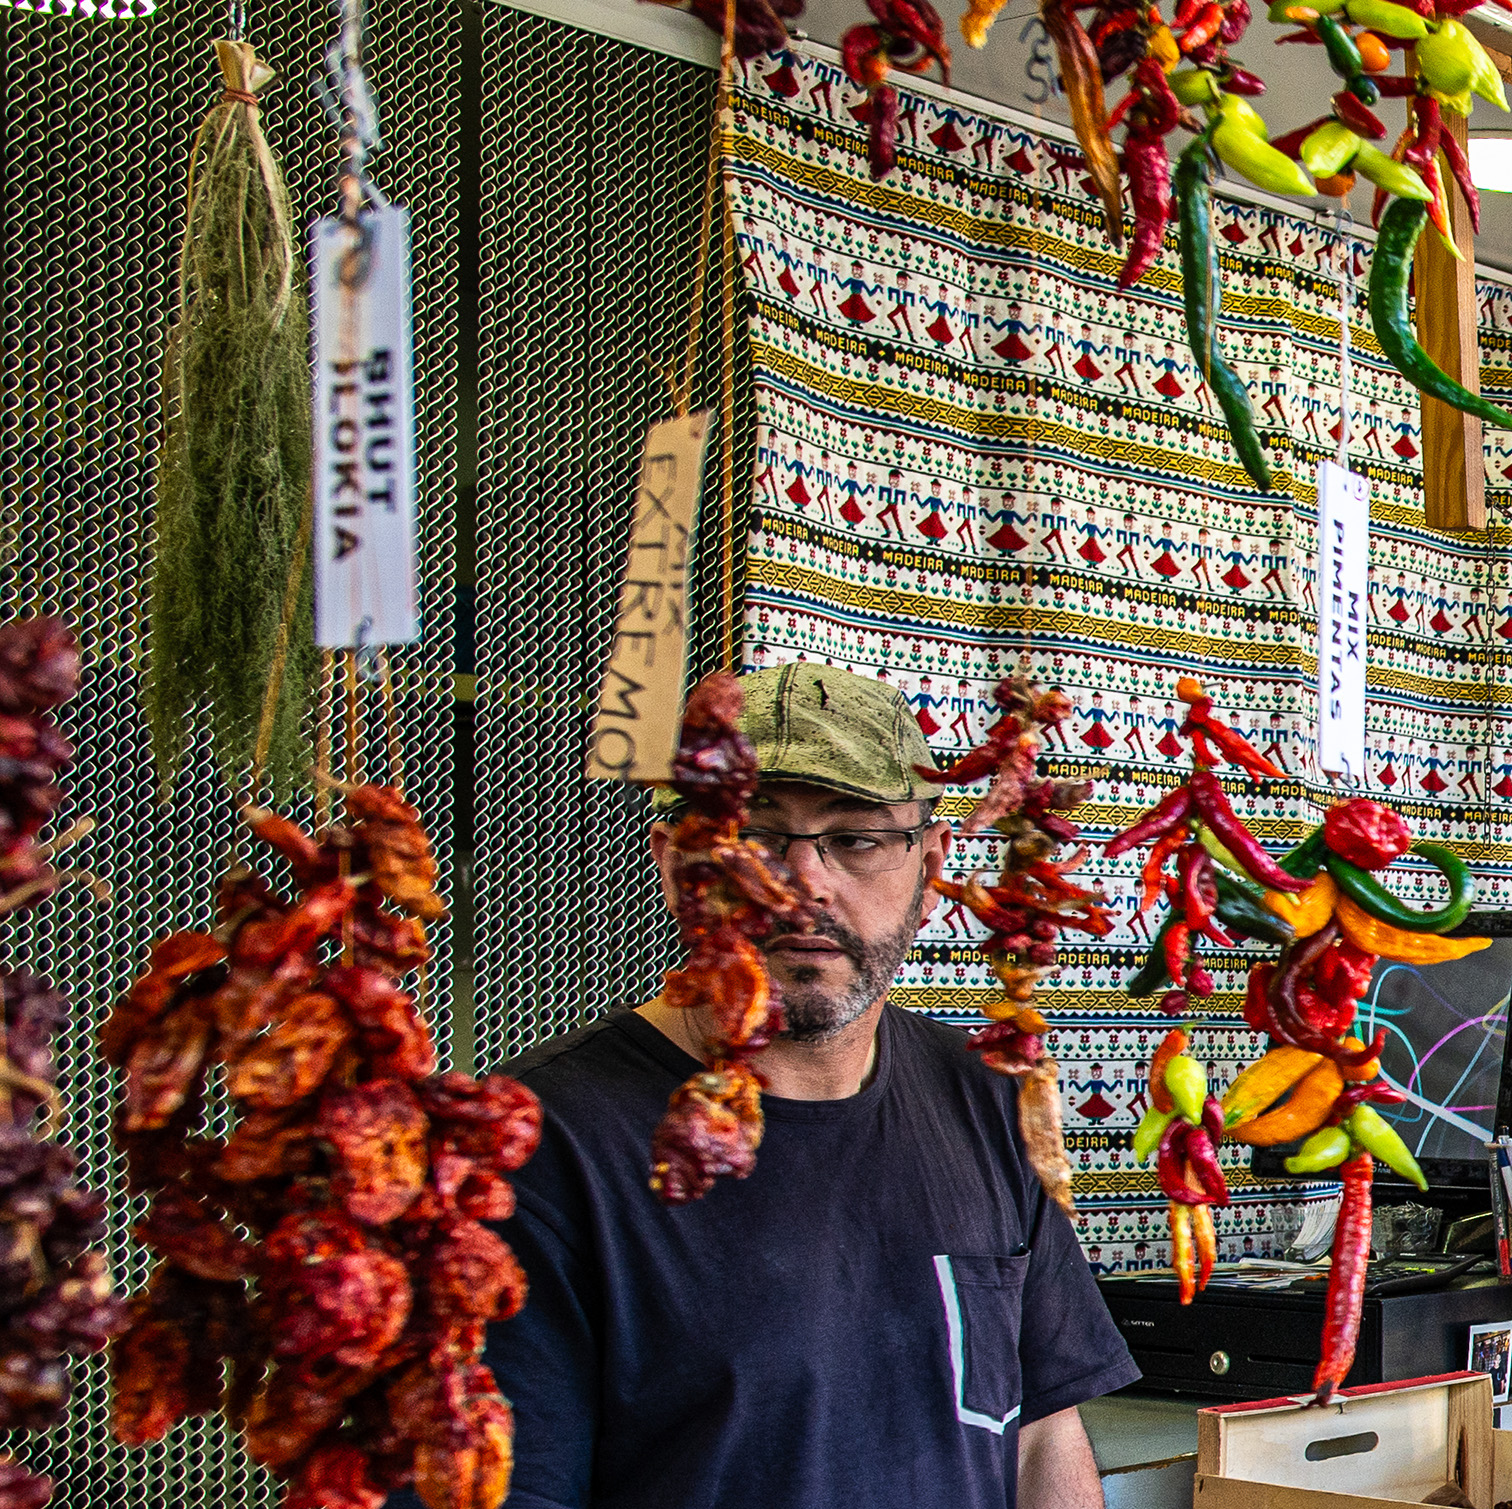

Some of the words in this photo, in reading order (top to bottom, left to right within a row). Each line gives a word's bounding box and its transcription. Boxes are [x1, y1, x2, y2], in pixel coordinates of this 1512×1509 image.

[814, 128, 869, 156] MADEIRA
[897, 155, 955, 181] MADEIRA
[969, 180, 1029, 204] MADEIRA
[1052, 203, 1102, 227] MADEIRA
[757, 302, 799, 329] MADEIRA
[816, 329, 867, 355] MADEIRA
[895, 352, 949, 375] MADEIRA
[962, 371, 1026, 391] MADEIRA
[1051, 387, 1098, 410] MADEIRA
[1123, 405, 1180, 427] MADEIRA
[1367, 466, 1414, 485] MADEIRA
[593, 453, 676, 774] EXTREMO
[761, 517, 809, 540] MADEIRA
[883, 551, 944, 571] MADEIRA
[961, 565, 1020, 581] MADEIRA
[1050, 574, 1103, 593] MADEIRA
[1124, 587, 1177, 605] MADEIRA
[1197, 600, 1245, 617] MADEIRA
[1329, 519, 1346, 720] PIMENTAS
[1347, 591, 1360, 660] MIX
[1048, 764, 1110, 778] MADEIRA
[1132, 771, 1181, 787] MADEIRA
[1401, 804, 1442, 818] MADEIRA
[1203, 957, 1248, 969] MADEIRA
